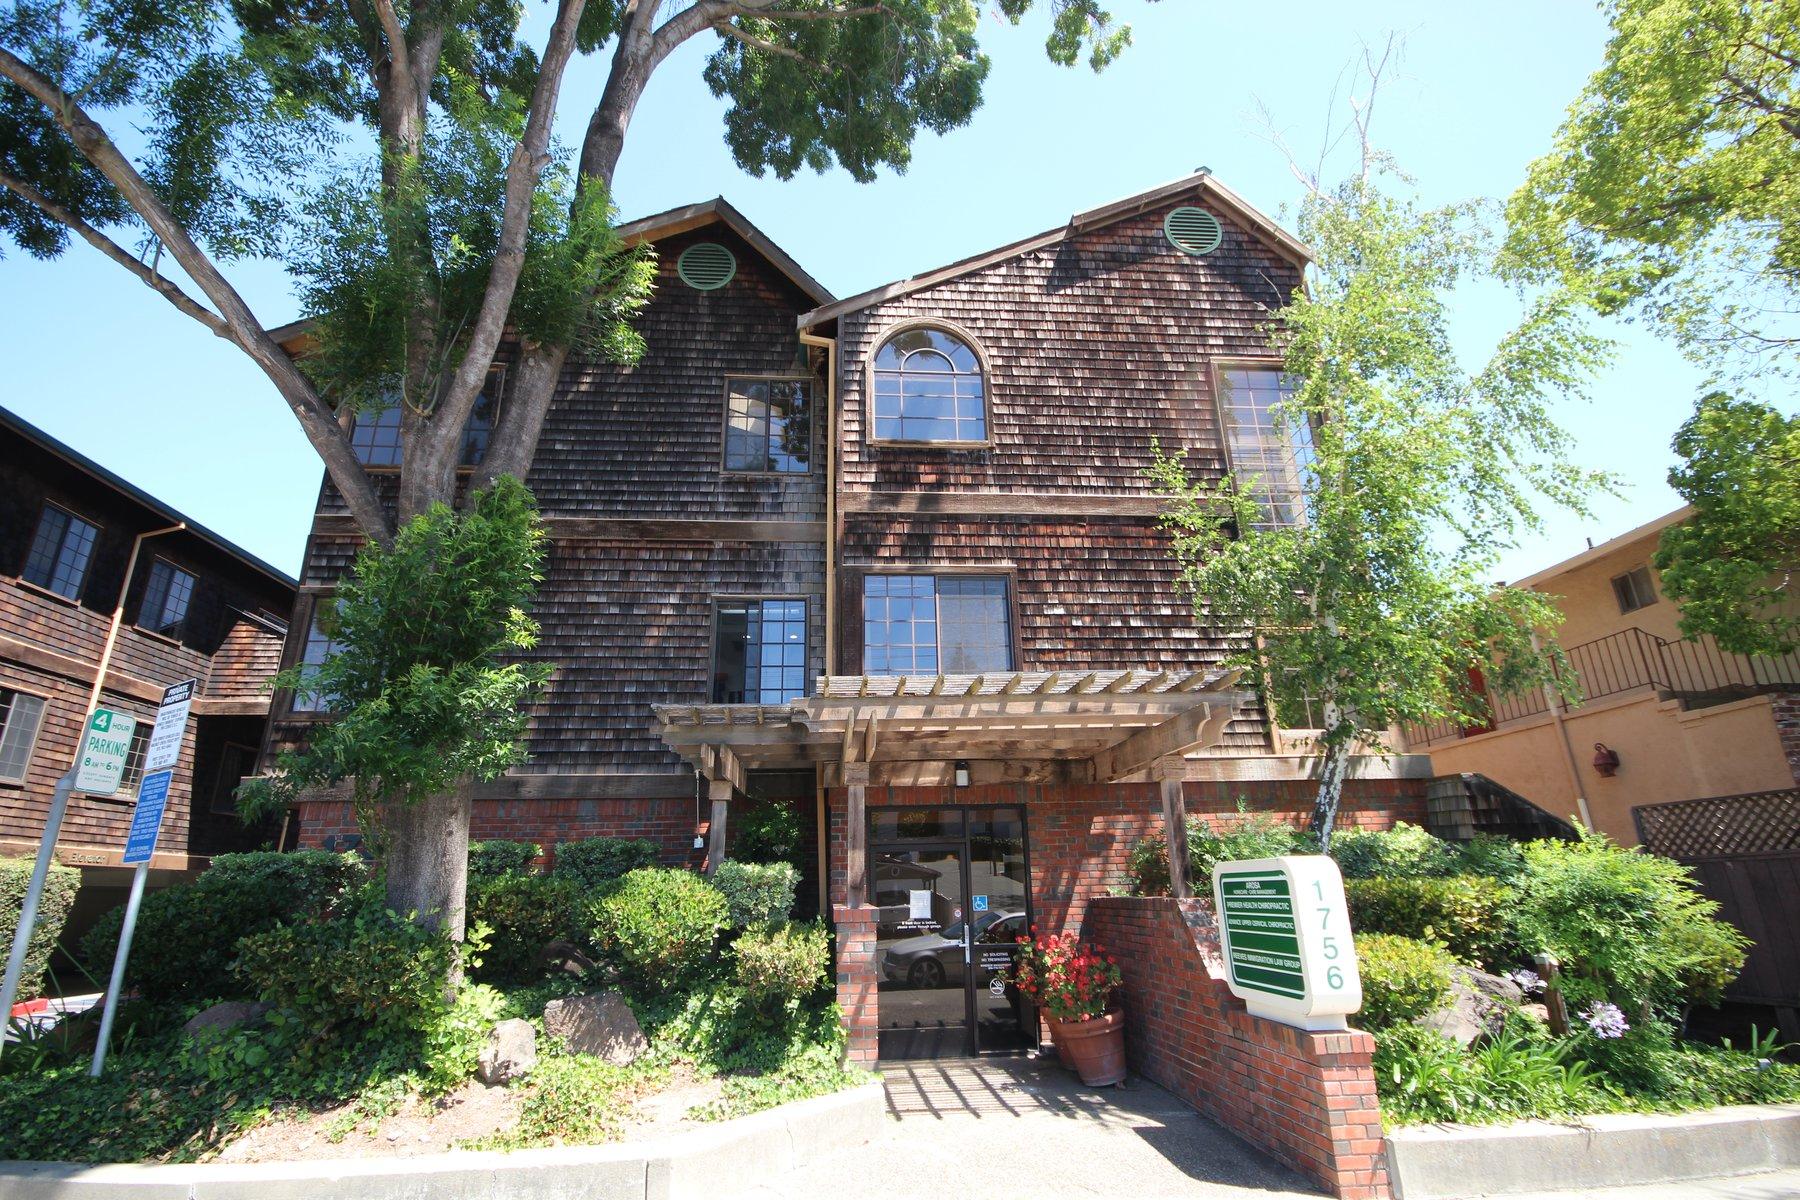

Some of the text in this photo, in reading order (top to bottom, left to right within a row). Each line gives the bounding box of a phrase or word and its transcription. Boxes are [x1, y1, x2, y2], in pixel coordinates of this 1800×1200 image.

[168, 684, 189, 696] PRIVATE
[163, 691, 190, 705] PROPERTY
[95, 713, 130, 732] 4 HOUR
[88, 736, 127, 757] PARKING
[85, 757, 92, 766] 8
[106, 762, 112, 770] 6
[70, 852, 106, 865] Elevator
[1258, 902, 1289, 910] CHIROPRACTIC
[1268, 921, 1294, 929] CHIROPRACTIC
[1247, 954, 1273, 964] IMMIGRATION
[1274, 958, 1283, 966] LAW
[1284, 959, 1300, 969] GROUP
